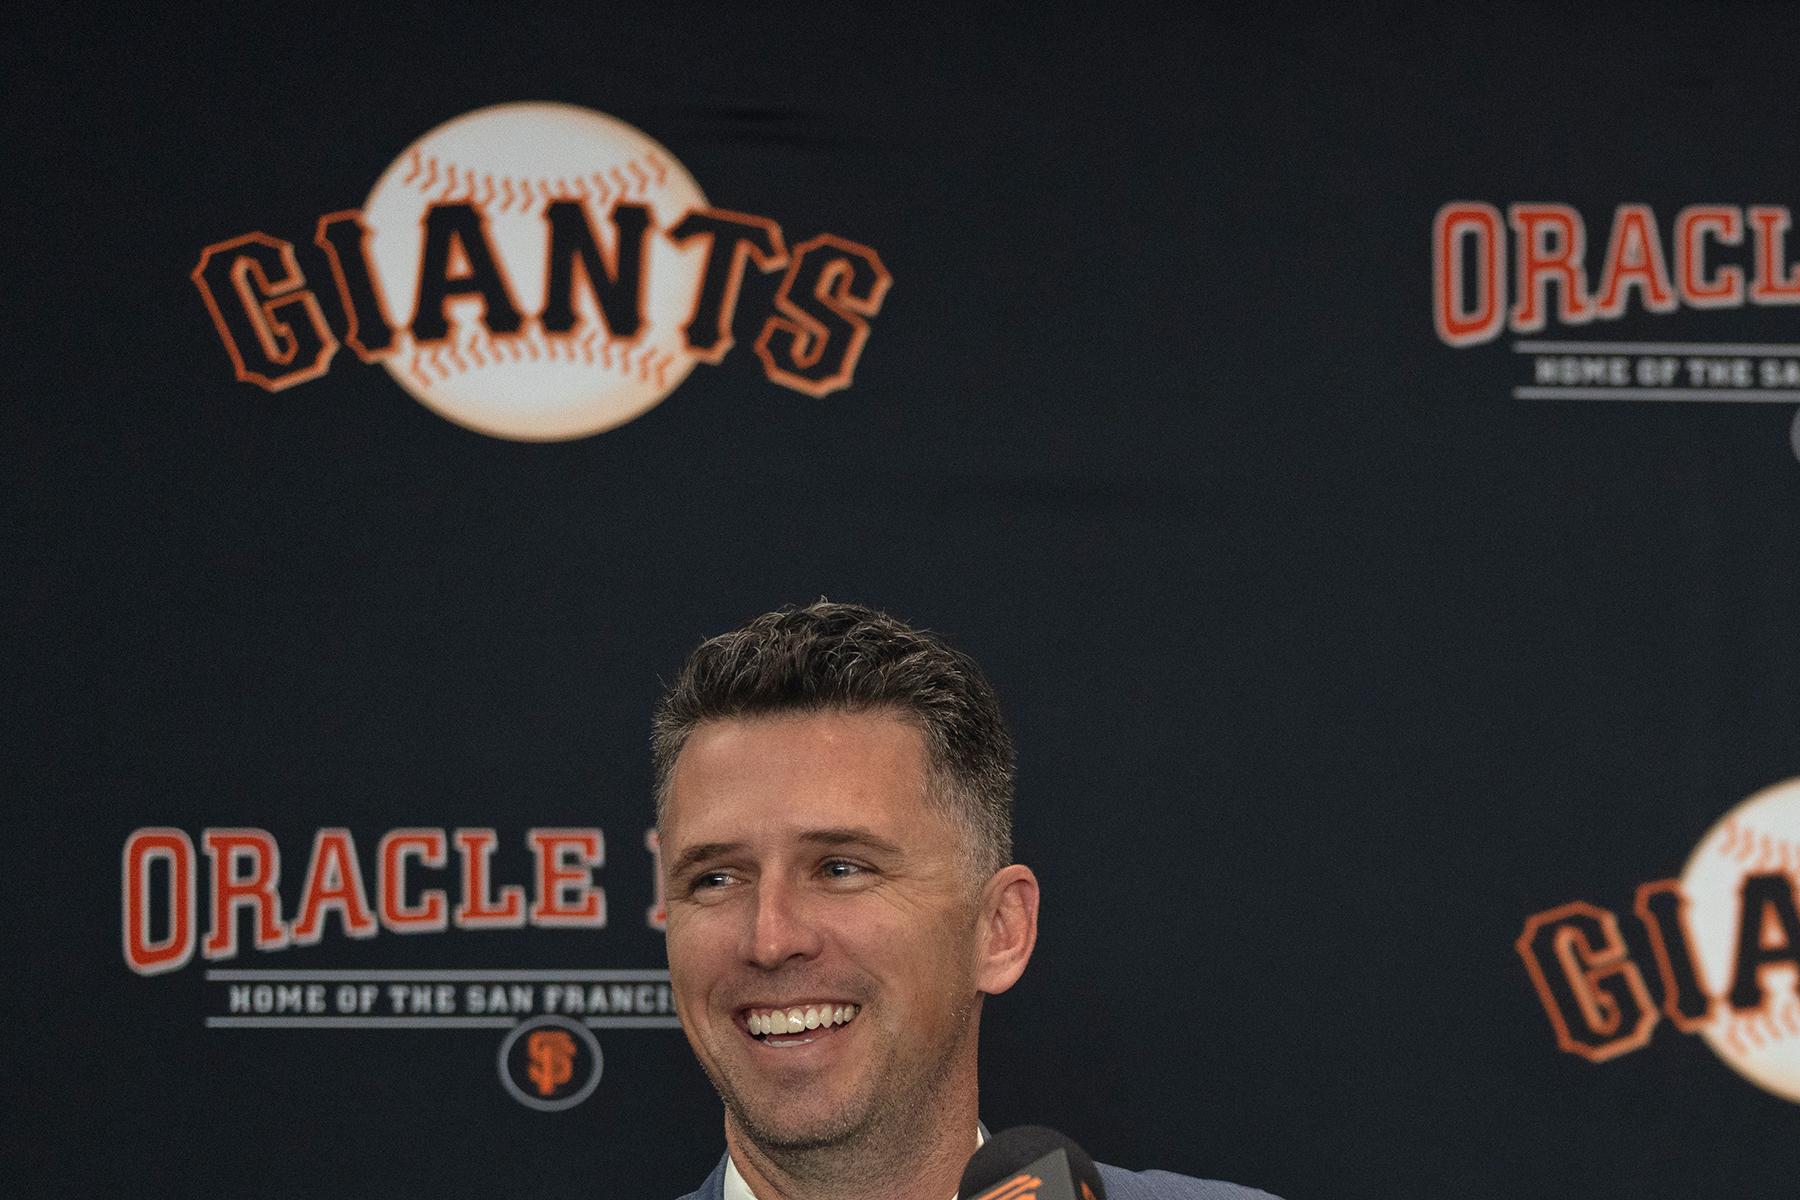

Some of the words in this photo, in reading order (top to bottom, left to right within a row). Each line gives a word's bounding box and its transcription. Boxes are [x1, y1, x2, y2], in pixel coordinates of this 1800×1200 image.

[191, 199, 893, 397] GIANTS
[1534, 356, 1630, 386] HOME
[1637, 356, 1681, 386] OF
[1687, 357, 1753, 387] THE
[121, 826, 607, 975] ORACLE
[228, 984, 327, 1014] HOME
[336, 984, 379, 1014] OF
[387, 984, 456, 1014] THE
[465, 984, 534, 1014] SAN
[543, 984, 676, 1014] FRANCI
